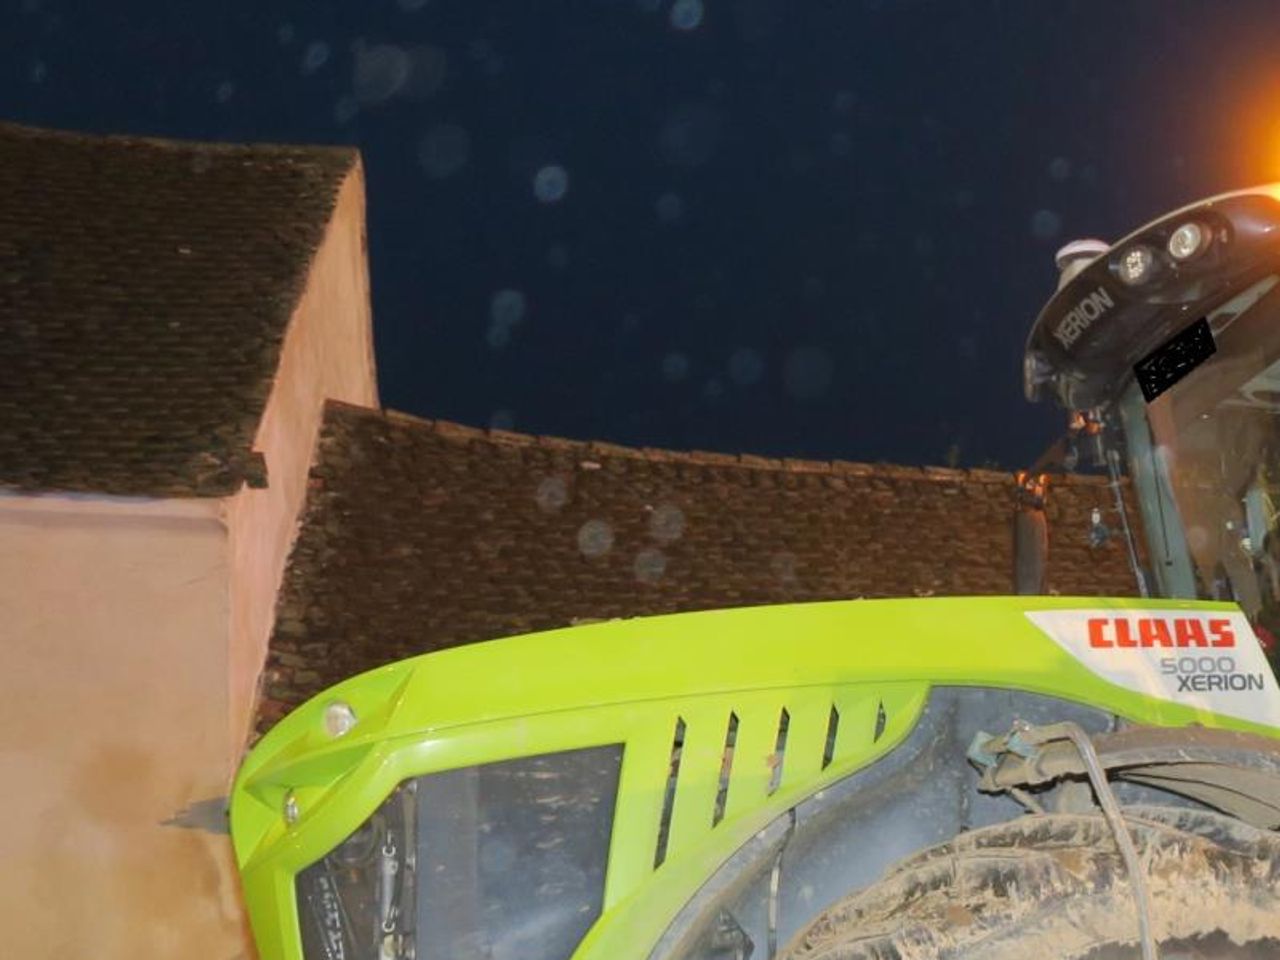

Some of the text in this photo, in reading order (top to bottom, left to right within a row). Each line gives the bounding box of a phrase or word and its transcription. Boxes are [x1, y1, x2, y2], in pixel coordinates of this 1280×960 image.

[1053, 286, 1115, 349] XERION
[1088, 618, 1236, 648] CLAAS
[1160, 657, 1235, 675] 5000
[1177, 673, 1264, 692] XERION
